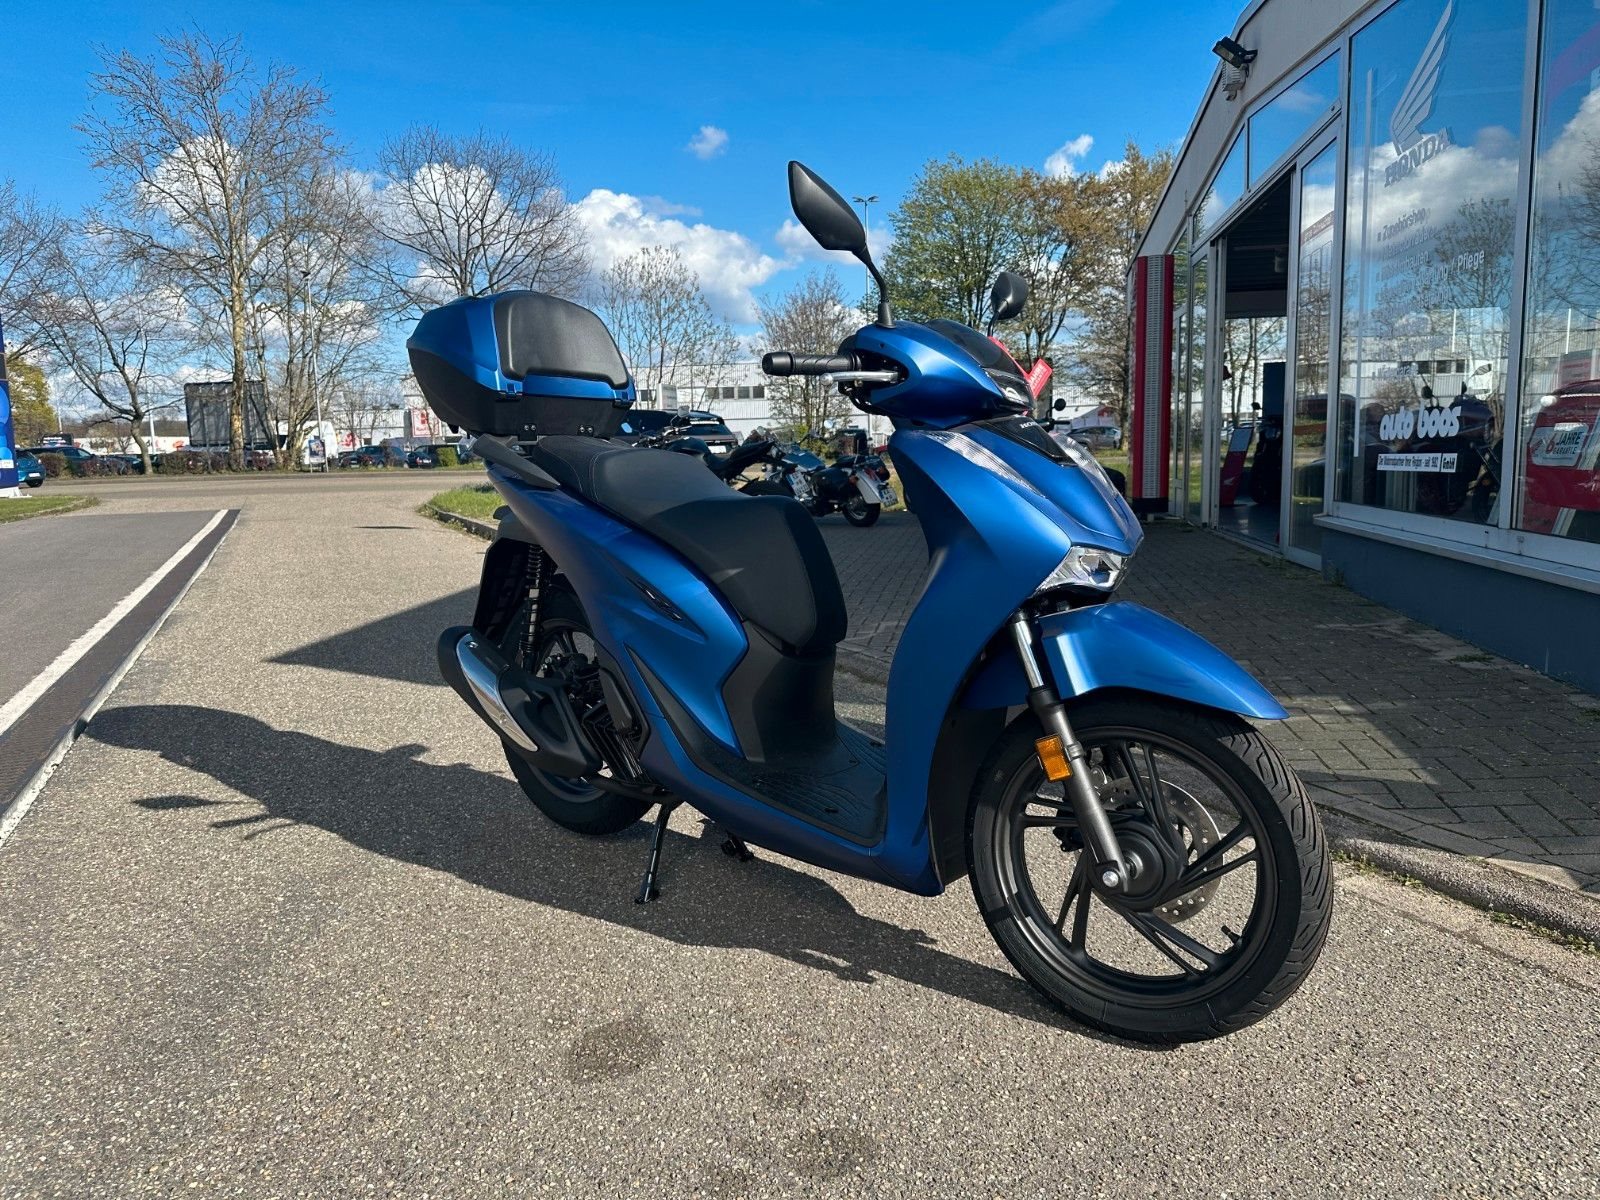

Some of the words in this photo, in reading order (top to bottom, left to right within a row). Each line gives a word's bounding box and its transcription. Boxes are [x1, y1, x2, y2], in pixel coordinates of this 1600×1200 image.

[1384, 127, 1450, 188] HONDA
[1457, 249, 1485, 271] Pflege
[1380, 406, 1414, 440] auto
[1417, 399, 1461, 438] boos
[1556, 431, 1583, 446] JAHRE
[1442, 457, 1456, 470] GmbH
